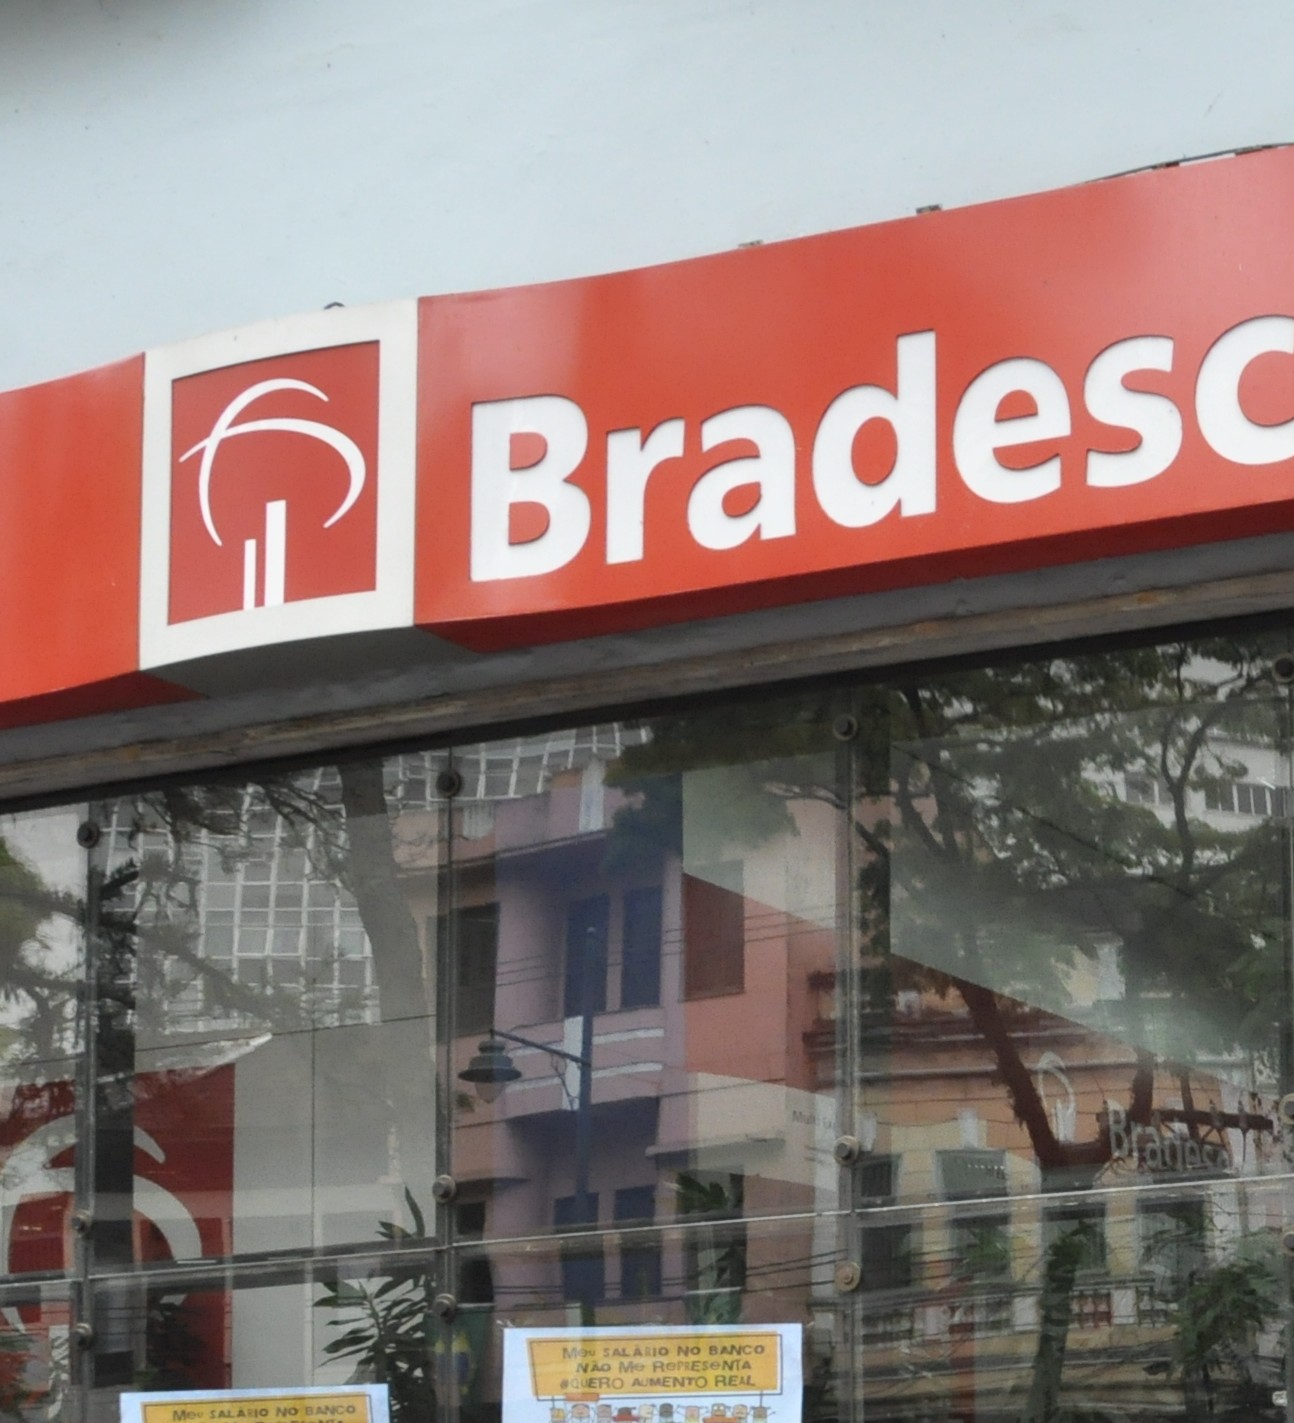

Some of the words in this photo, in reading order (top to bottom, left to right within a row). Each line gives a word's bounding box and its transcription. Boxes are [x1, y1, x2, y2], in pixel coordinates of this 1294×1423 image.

[603, 1345, 669, 1357] SALÁRIO
[677, 1345, 701, 1357] NO
[709, 1344, 765, 1355] BANCO
[631, 1376, 708, 1389] AUMENTO
[715, 1374, 756, 1387] REAL
[276, 1406, 299, 1417] NO
[305, 1405, 356, 1416] BANCO
